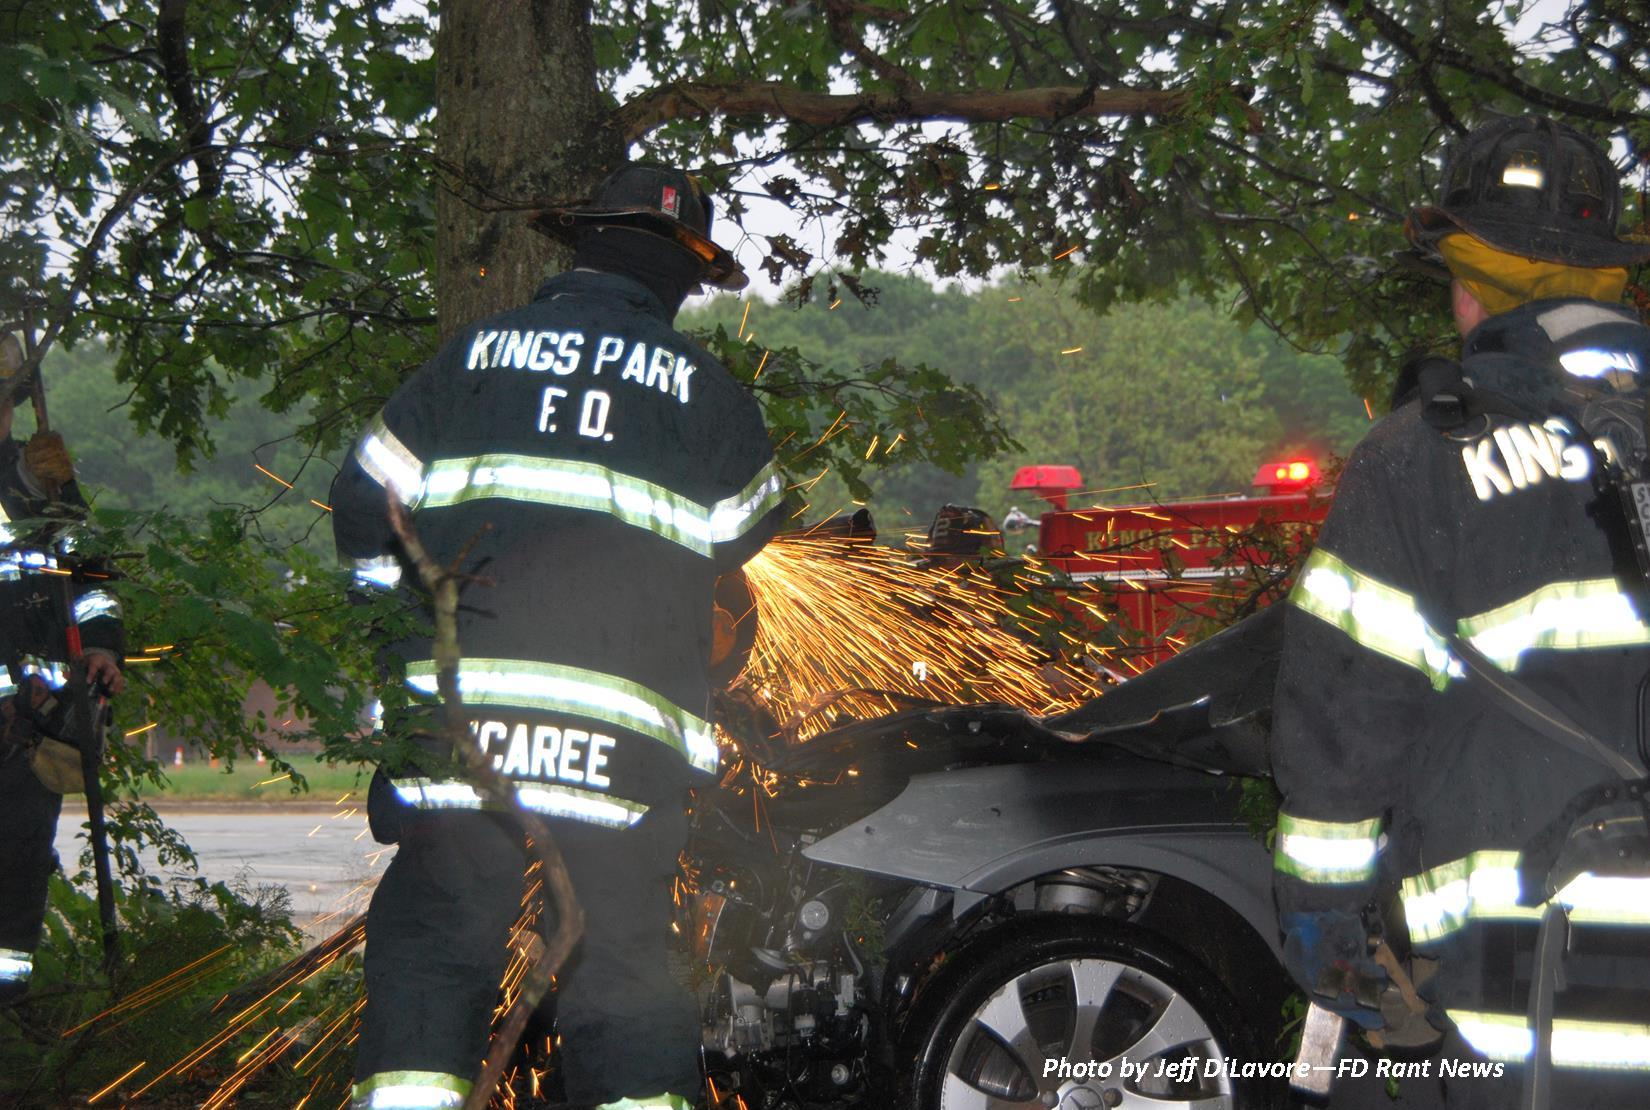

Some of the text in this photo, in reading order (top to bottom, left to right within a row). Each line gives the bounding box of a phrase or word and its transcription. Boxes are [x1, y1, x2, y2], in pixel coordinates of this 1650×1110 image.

[467, 330, 697, 403] KINGS PARK
[537, 386, 568, 433] F.
[470, 720, 616, 787] CAREE
